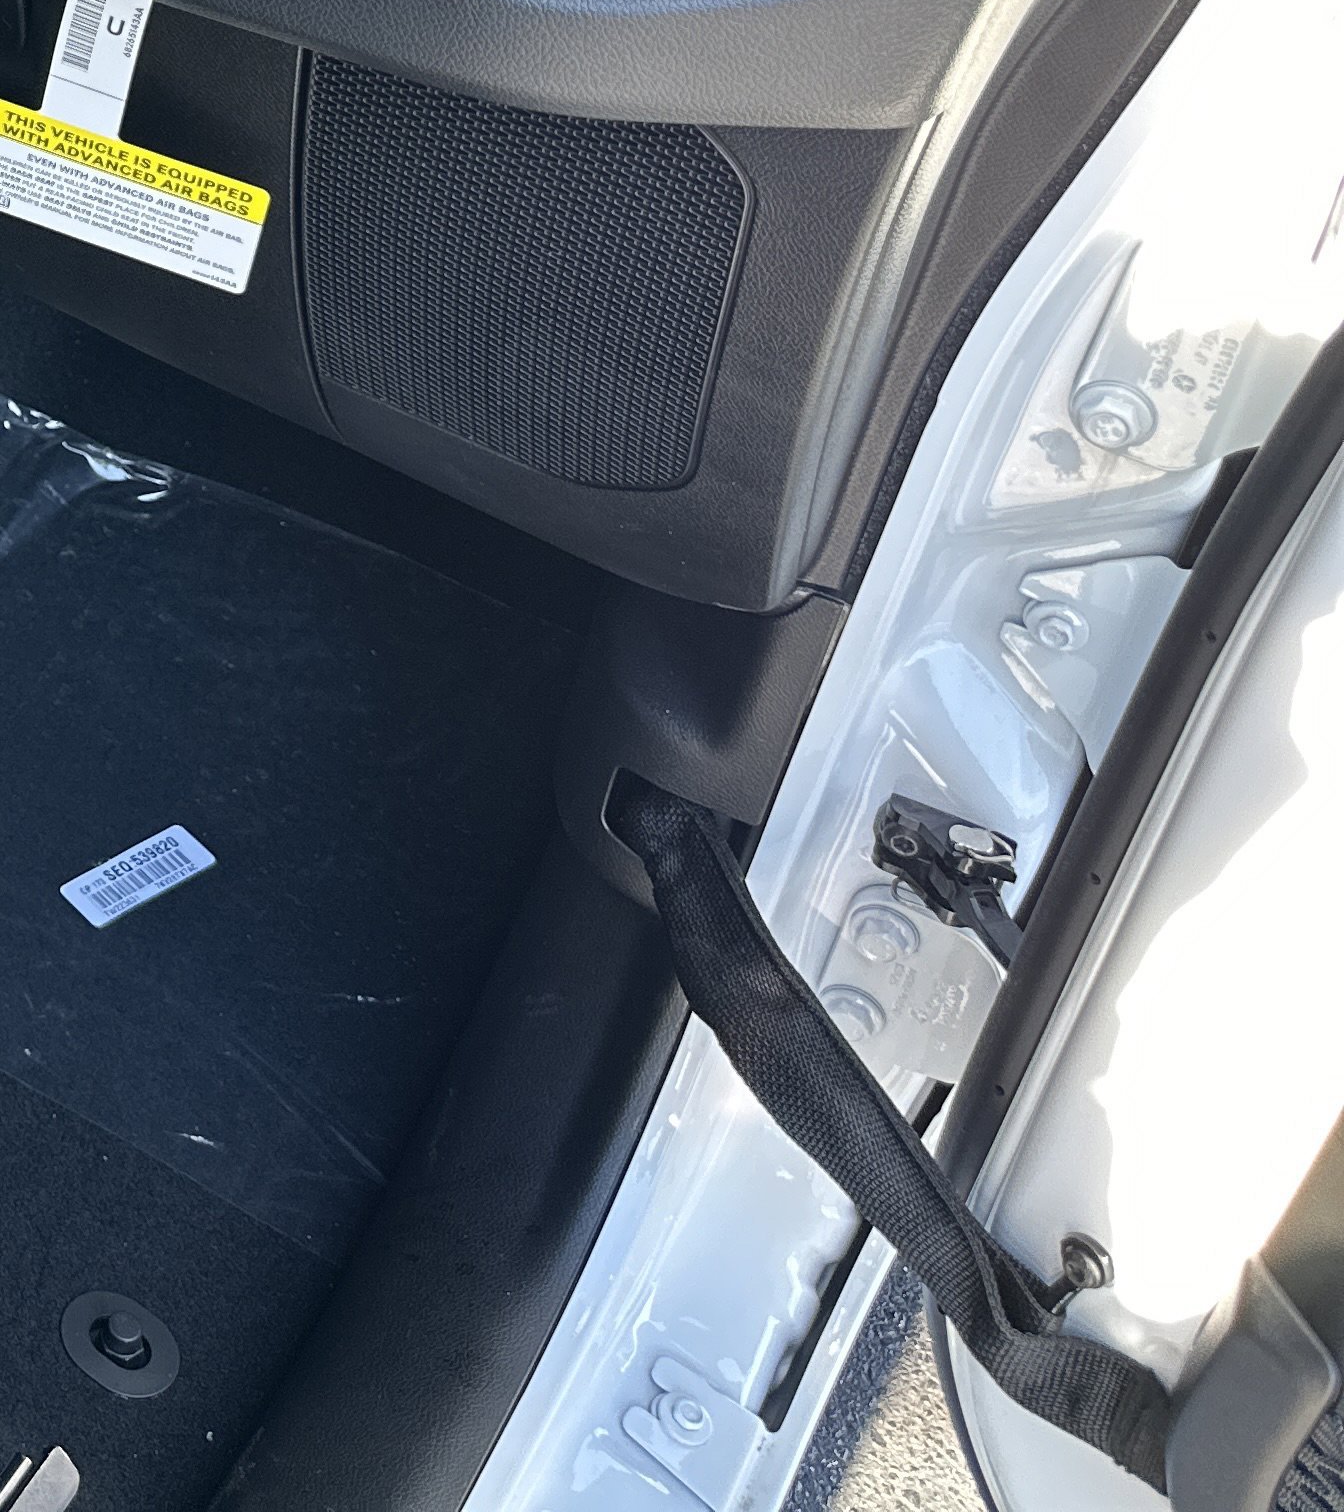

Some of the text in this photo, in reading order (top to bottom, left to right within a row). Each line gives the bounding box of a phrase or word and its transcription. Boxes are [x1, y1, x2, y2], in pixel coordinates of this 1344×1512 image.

[123, 6, 145, 59] 68265143AA
[1, 123, 250, 216] WITH ADVANCED AIR BAGS
[3, 110, 254, 204] THIS VEHICLE IS EQUIPPED
[25, 152, 210, 222] EVEN WITH ADVANCED AIR BAGS
